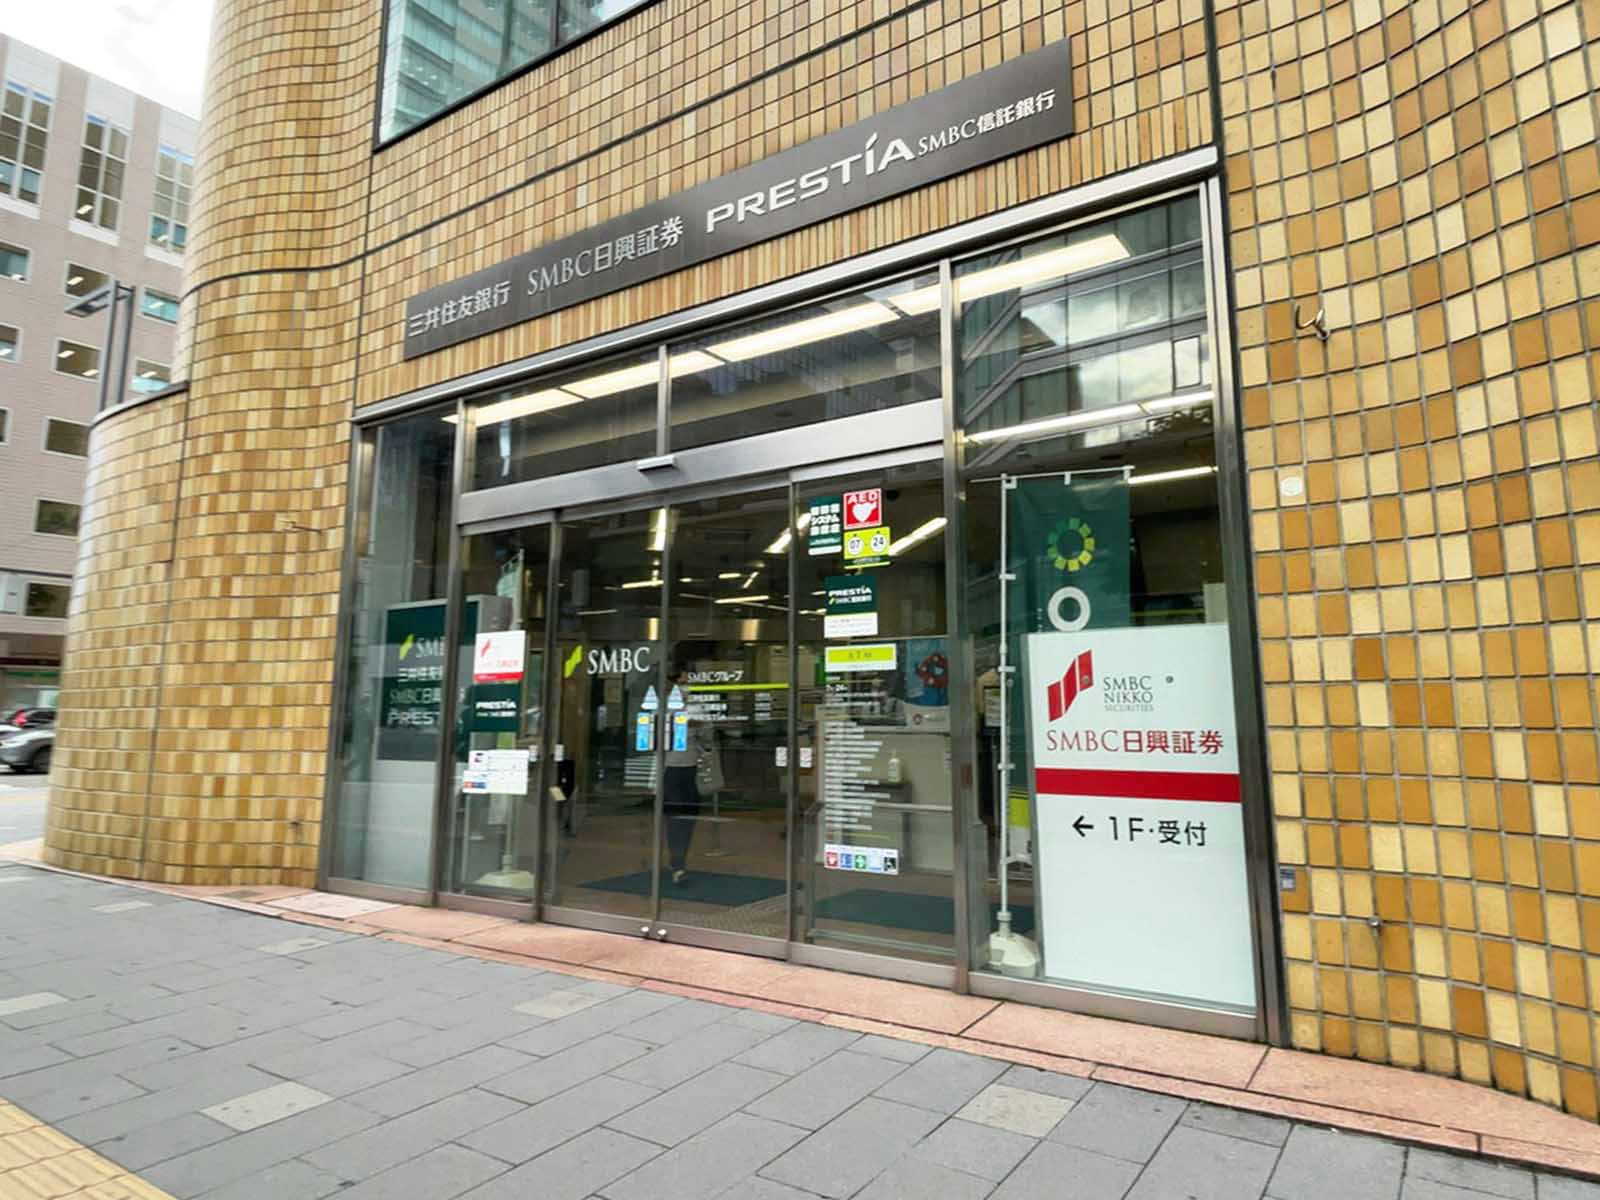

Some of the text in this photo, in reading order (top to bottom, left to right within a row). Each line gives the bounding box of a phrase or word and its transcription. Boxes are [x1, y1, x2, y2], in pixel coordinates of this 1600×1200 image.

[408, 280, 512, 337] 三井住友銀行
[527, 215, 685, 296] SMBC日興証券
[917, 88, 1056, 156] SMBC信託銀行
[847, 491, 879, 504] AED
[586, 645, 650, 675] SMBC
[1103, 675, 1152, 691] SMBC
[1104, 690, 1154, 704] NIKKO
[1104, 704, 1154, 713] SECURITIES
[1046, 730, 1224, 755] SMBC日興証券
